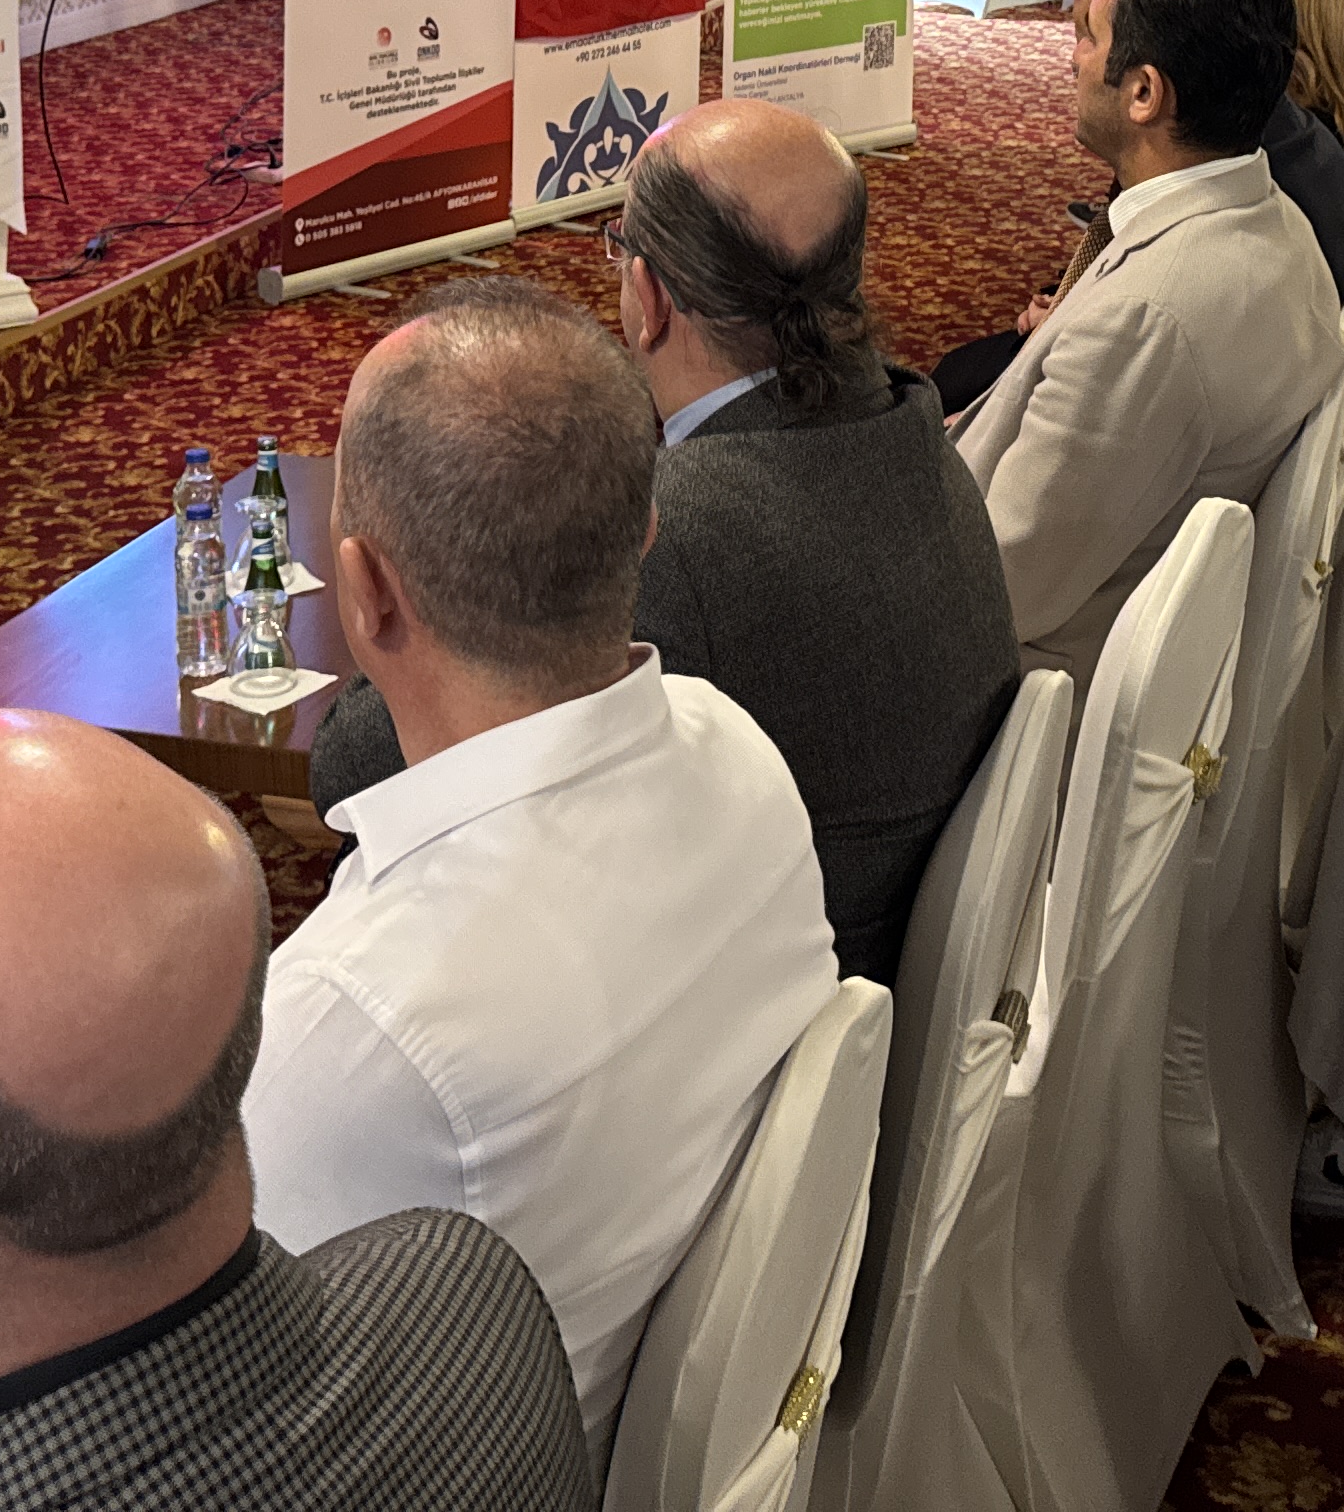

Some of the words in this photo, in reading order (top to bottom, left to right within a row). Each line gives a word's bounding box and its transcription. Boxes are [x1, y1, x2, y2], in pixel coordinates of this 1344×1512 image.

[576, 50, 589, 62] +90
[591, 48, 606, 60] 272
[622, 42, 632, 53] 44
[387, 70, 397, 80] Bu
[733, 70, 756, 82] Organ
[758, 66, 777, 77] Nakli
[320, 93, 335, 104] T.C.
[349, 100, 373, 111] Genel
